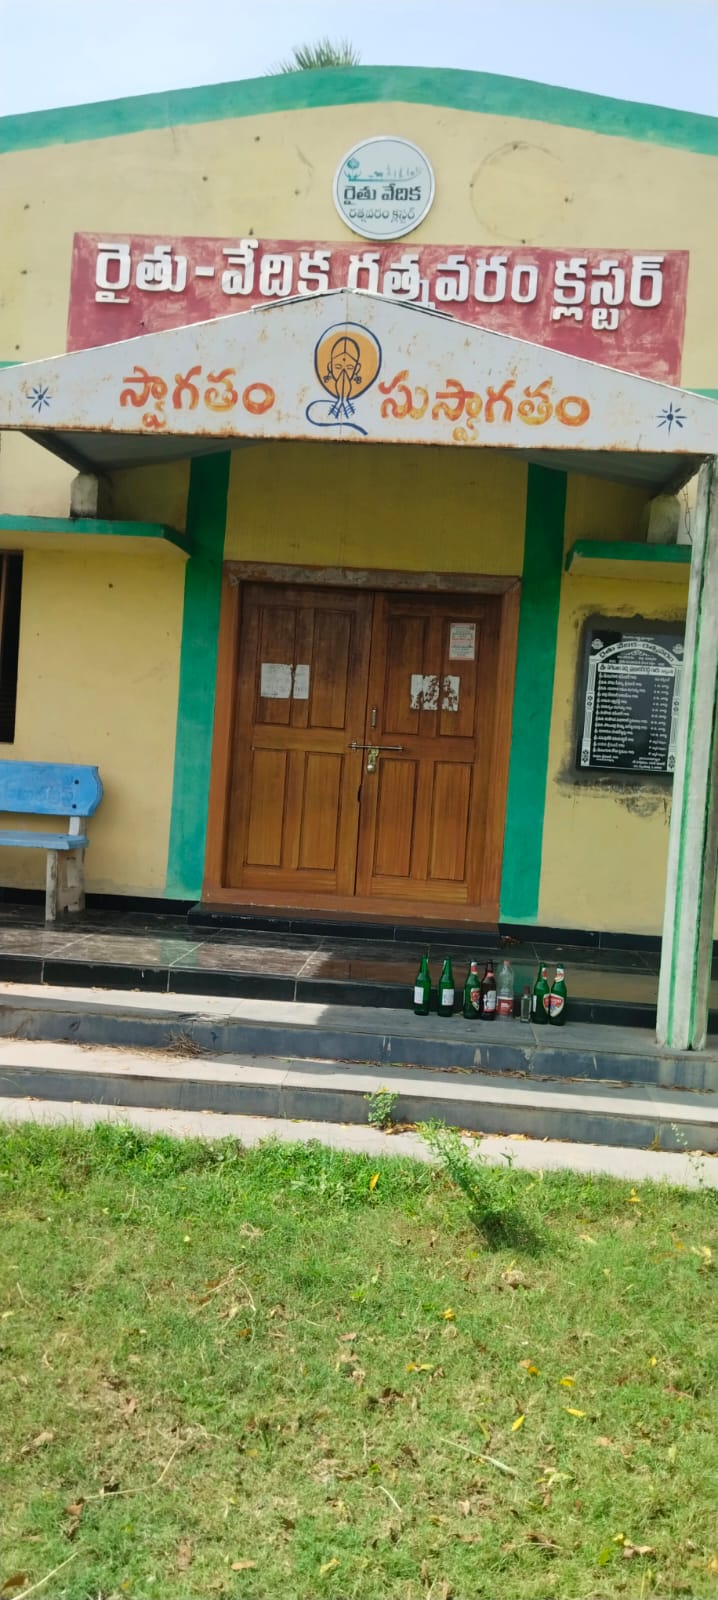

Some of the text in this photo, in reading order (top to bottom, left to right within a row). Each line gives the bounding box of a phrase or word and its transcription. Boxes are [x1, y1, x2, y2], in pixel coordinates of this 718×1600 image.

[343, 183, 421, 205] రైతు వేదిక
[348, 207, 390, 223] రత్నవరం
[347, 252, 539, 310] రత్నవరం
[551, 255, 665, 331] క్లస్టర్
[119, 365, 591, 442] స్వాగతం సుస్వాగతం
